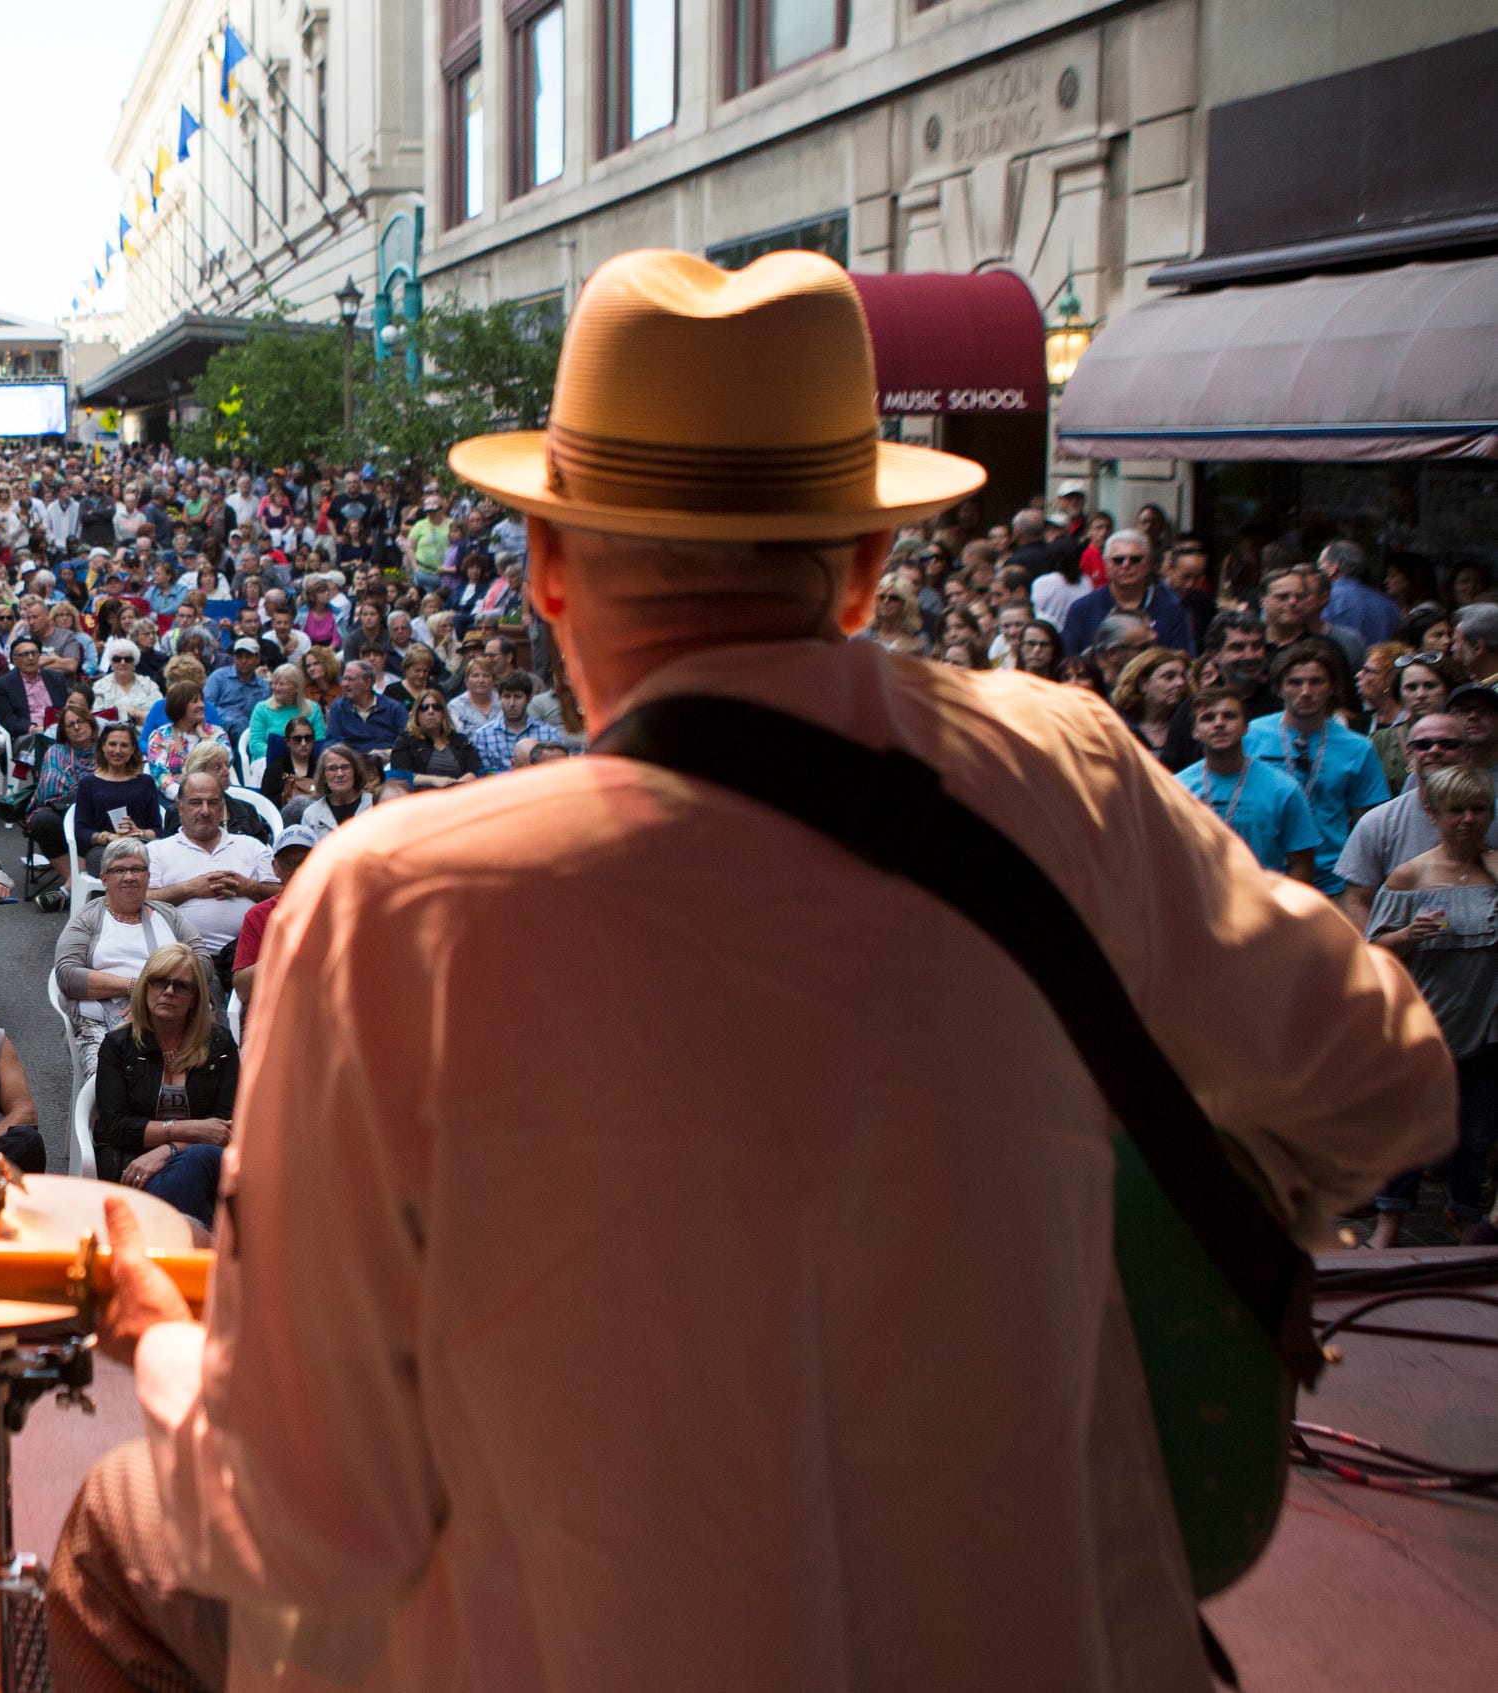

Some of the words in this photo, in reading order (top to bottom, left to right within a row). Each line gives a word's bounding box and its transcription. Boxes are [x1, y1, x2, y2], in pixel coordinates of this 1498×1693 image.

[953, 60, 1042, 121] LINCOLN
[953, 105, 1043, 162] BUILDING
[883, 389, 943, 410] MUSIC
[947, 388, 1029, 410] SCHOOL
